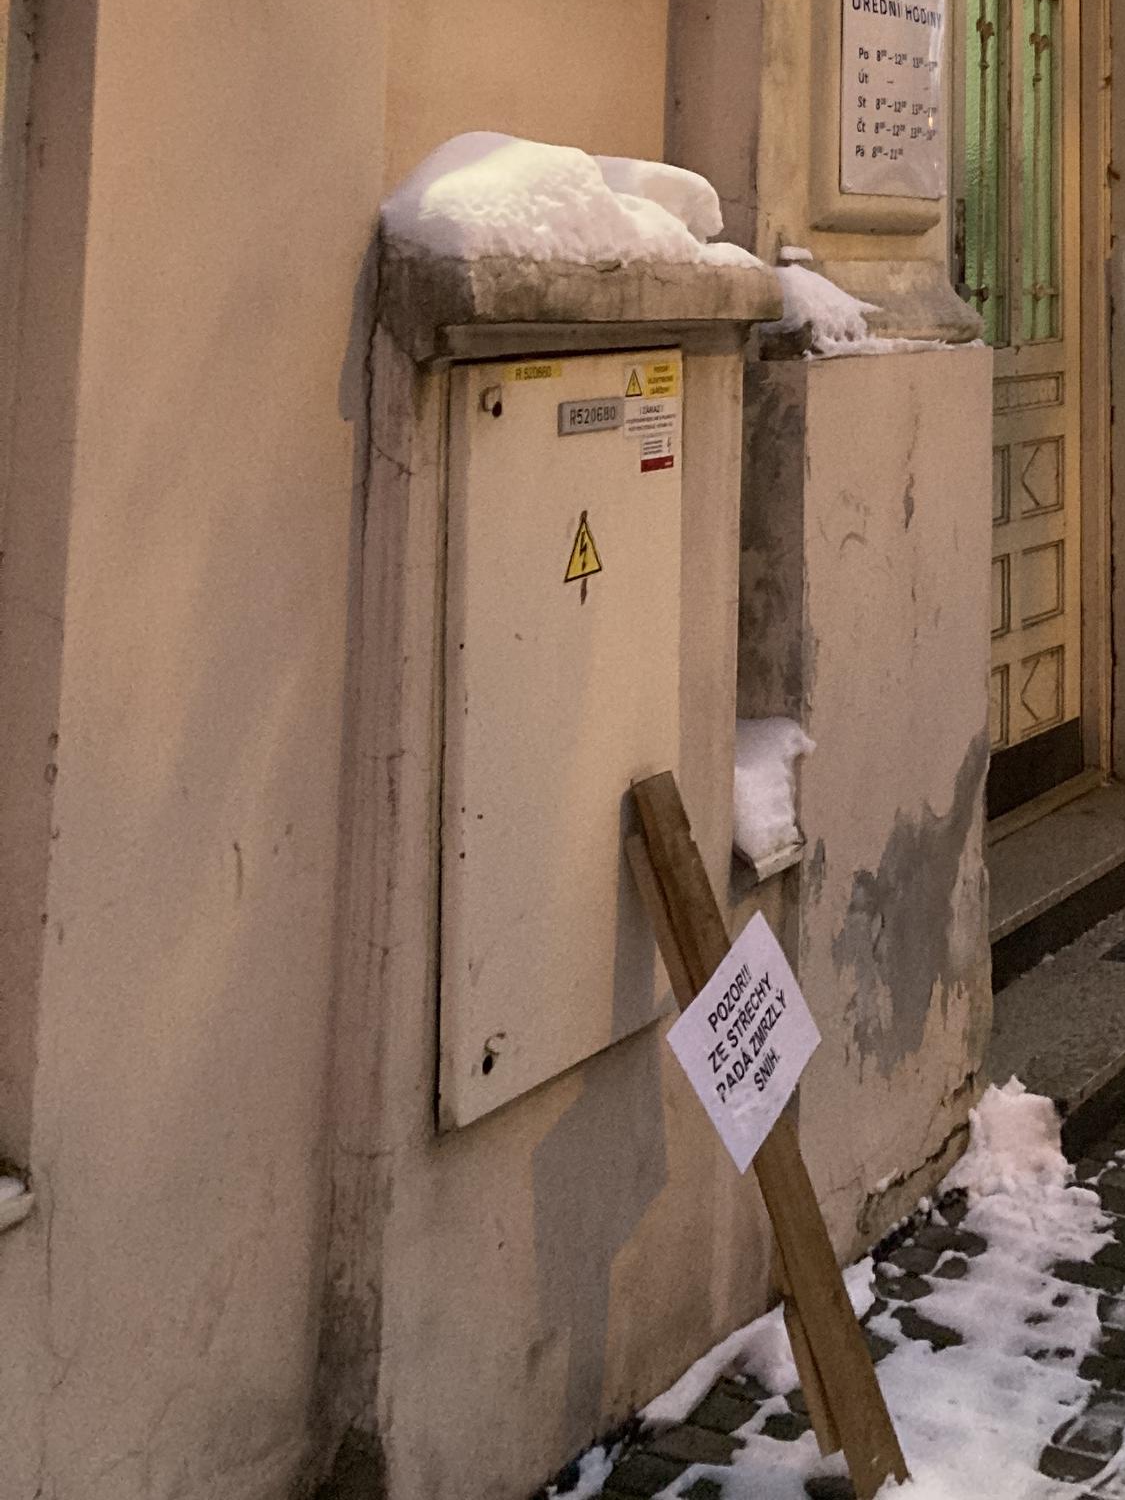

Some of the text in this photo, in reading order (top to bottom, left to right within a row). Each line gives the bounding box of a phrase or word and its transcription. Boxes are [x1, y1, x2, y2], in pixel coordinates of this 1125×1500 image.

[859, 47, 869, 60] Po
[858, 69, 869, 84] Út
[569, 405, 617, 427] R520680
[707, 971, 772, 1074] ZE STŘECHY
[749, 988, 787, 1058] ZMRZLÝ
